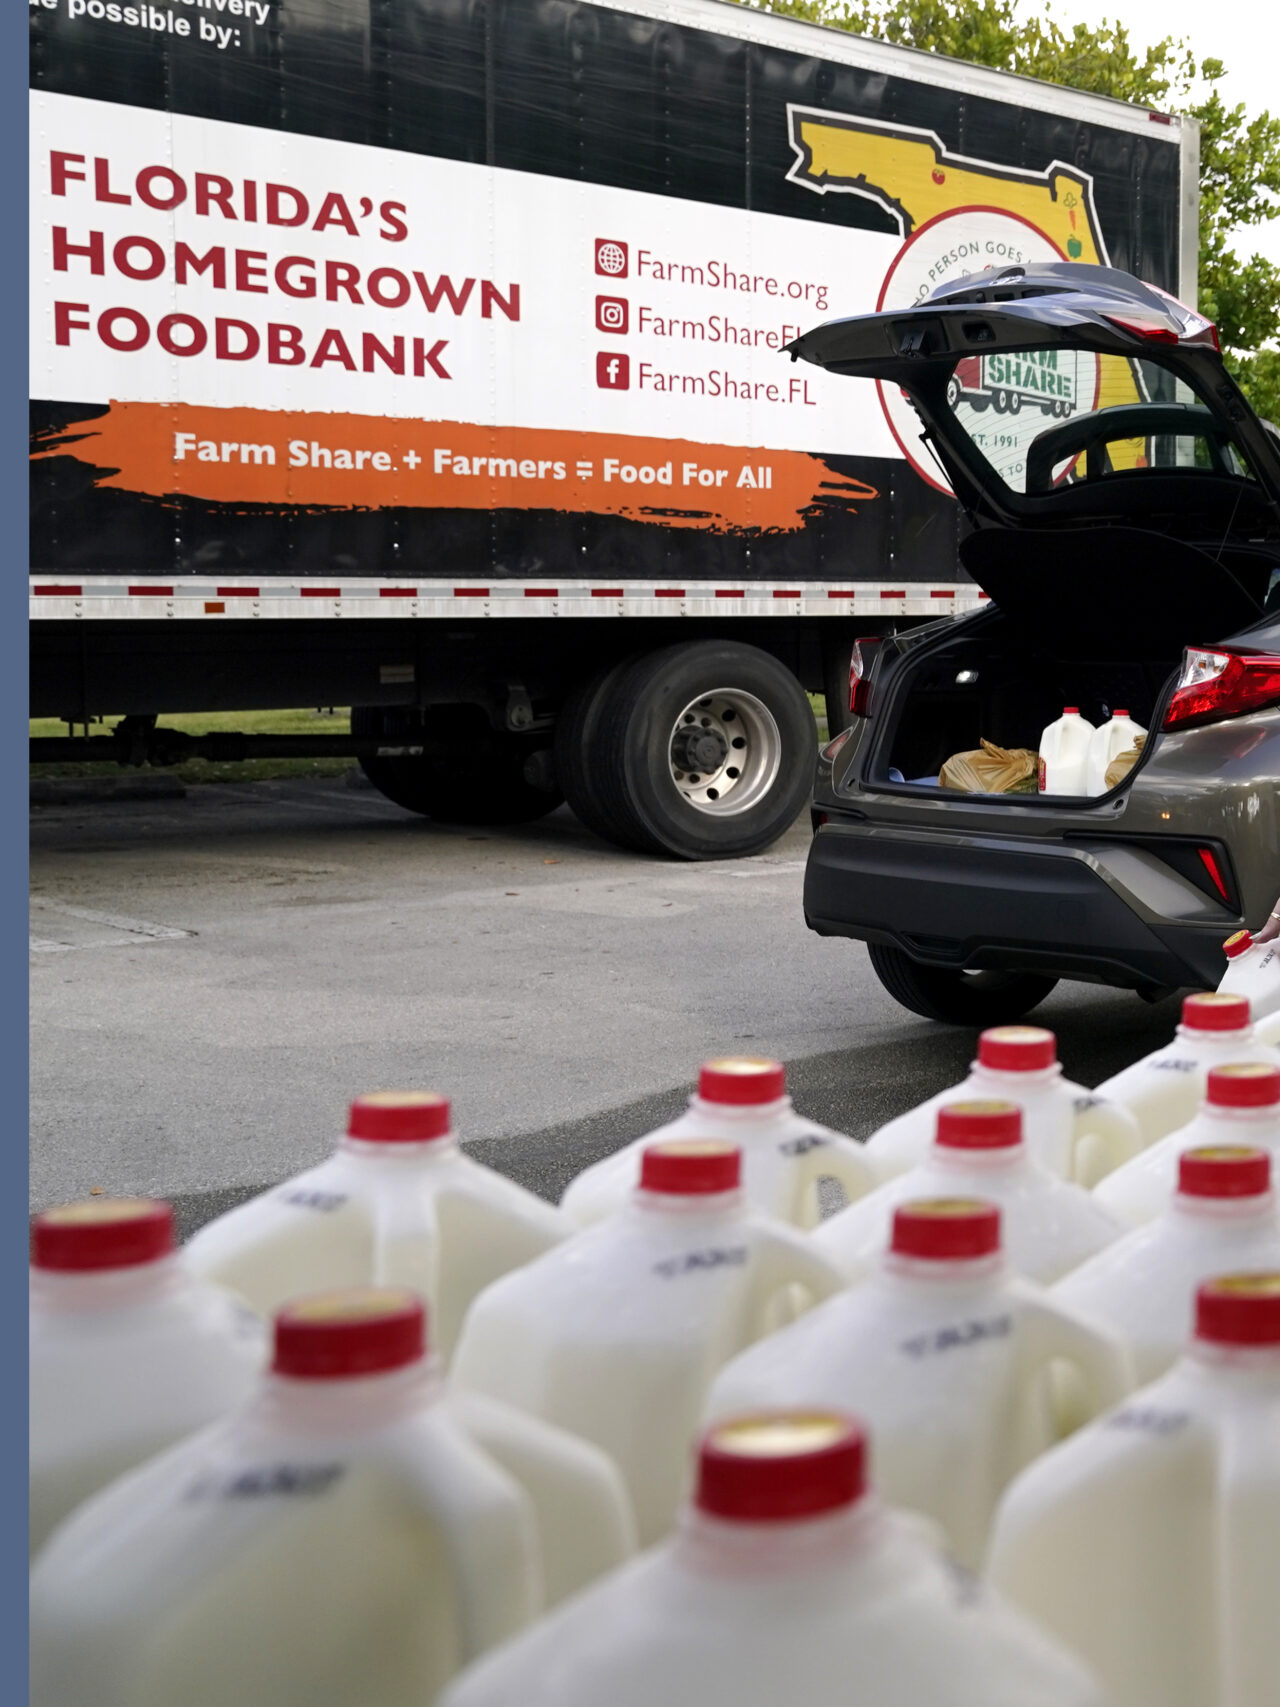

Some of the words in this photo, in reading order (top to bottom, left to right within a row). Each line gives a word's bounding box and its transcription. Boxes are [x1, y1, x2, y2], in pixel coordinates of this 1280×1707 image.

[68, 0, 190, 37] possible
[199, 17, 241, 49] by:
[50, 150, 408, 242] FLORIDA'S
[52, 226, 520, 322] HOMEGROWN
[637, 250, 829, 311] FarmShare.org
[928, 241, 980, 282] PERSON
[985, 241, 1024, 263] GOES
[54, 300, 452, 379] FOODBANK
[639, 363, 817, 406] FarmShare.FL
[988, 355, 1072, 399] SHARE
[175, 432, 276, 465] Farm
[288, 440, 391, 471] Share
[402, 450, 422, 470] +
[433, 449, 566, 480] Farmers
[576, 461, 593, 477] =
[603, 458, 672, 485] Food
[682, 462, 728, 487] For
[736, 465, 772, 489] All
[993, 434, 1018, 448] 1991
[1008, 463, 1023, 476] TO
